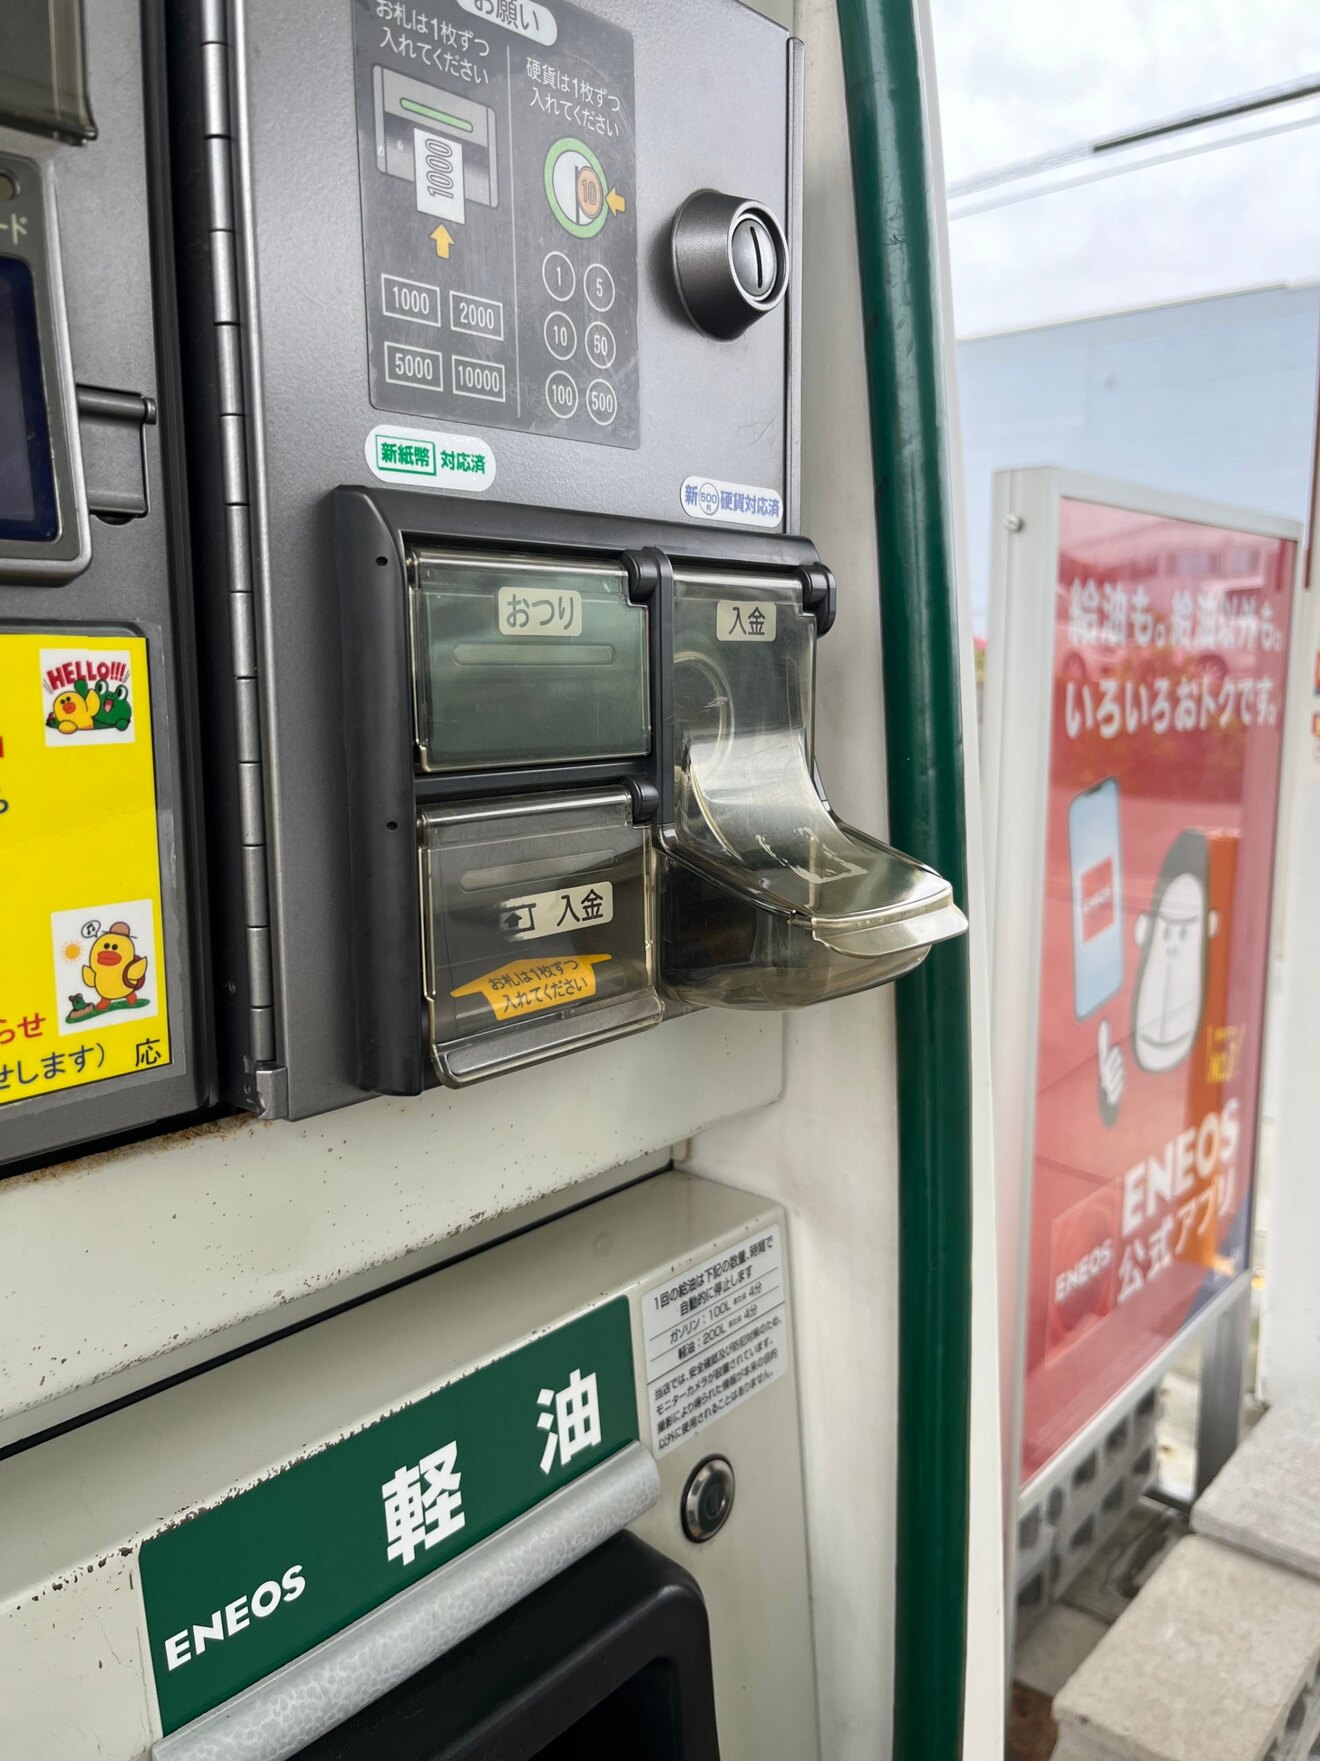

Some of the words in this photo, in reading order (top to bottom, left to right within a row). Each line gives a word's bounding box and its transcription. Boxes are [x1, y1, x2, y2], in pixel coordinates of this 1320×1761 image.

[376, 0, 489, 56] お札は1枚ずつ
[380, 26, 489, 84] 入れてください
[526, 57, 620, 112] 硬貨は1枚ずつ
[530, 87, 619, 137] 入れてください
[425, 138, 454, 200] 1000
[582, 180, 597, 205] 10
[555, 266, 563, 287] 1
[595, 277, 604, 298] 5
[392, 285, 430, 314] 1000
[459, 302, 495, 330] 2000
[553, 325, 568, 347] 10
[593, 332, 608, 356] 50
[394, 353, 433, 381] 5000
[457, 365, 500, 393] 10000
[551, 384, 573, 407] 100
[591, 391, 613, 413] 500
[381, 442, 430, 467] 新紙幣
[440, 449, 486, 475] 対応済
[506, 594, 574, 630] おつり
[728, 606, 765, 636] 入金
[46, 660, 127, 691] HELLO!!!
[1065, 675, 1278, 740] いろいろおトクです。
[557, 888, 603, 927] 入金
[488, 959, 579, 992] お札は1枚ずつ
[503, 976, 588, 1013] 入れてください
[135, 1038, 161, 1067] 応
[1121, 1097, 1239, 1238] ENEOS
[1117, 1167, 1236, 1303] 公式アプリ
[1055, 1238, 1113, 1304] ENEOS
[680, 1265, 752, 1317] 自動的に停止します
[164, 1564, 306, 1671] ENEOS
